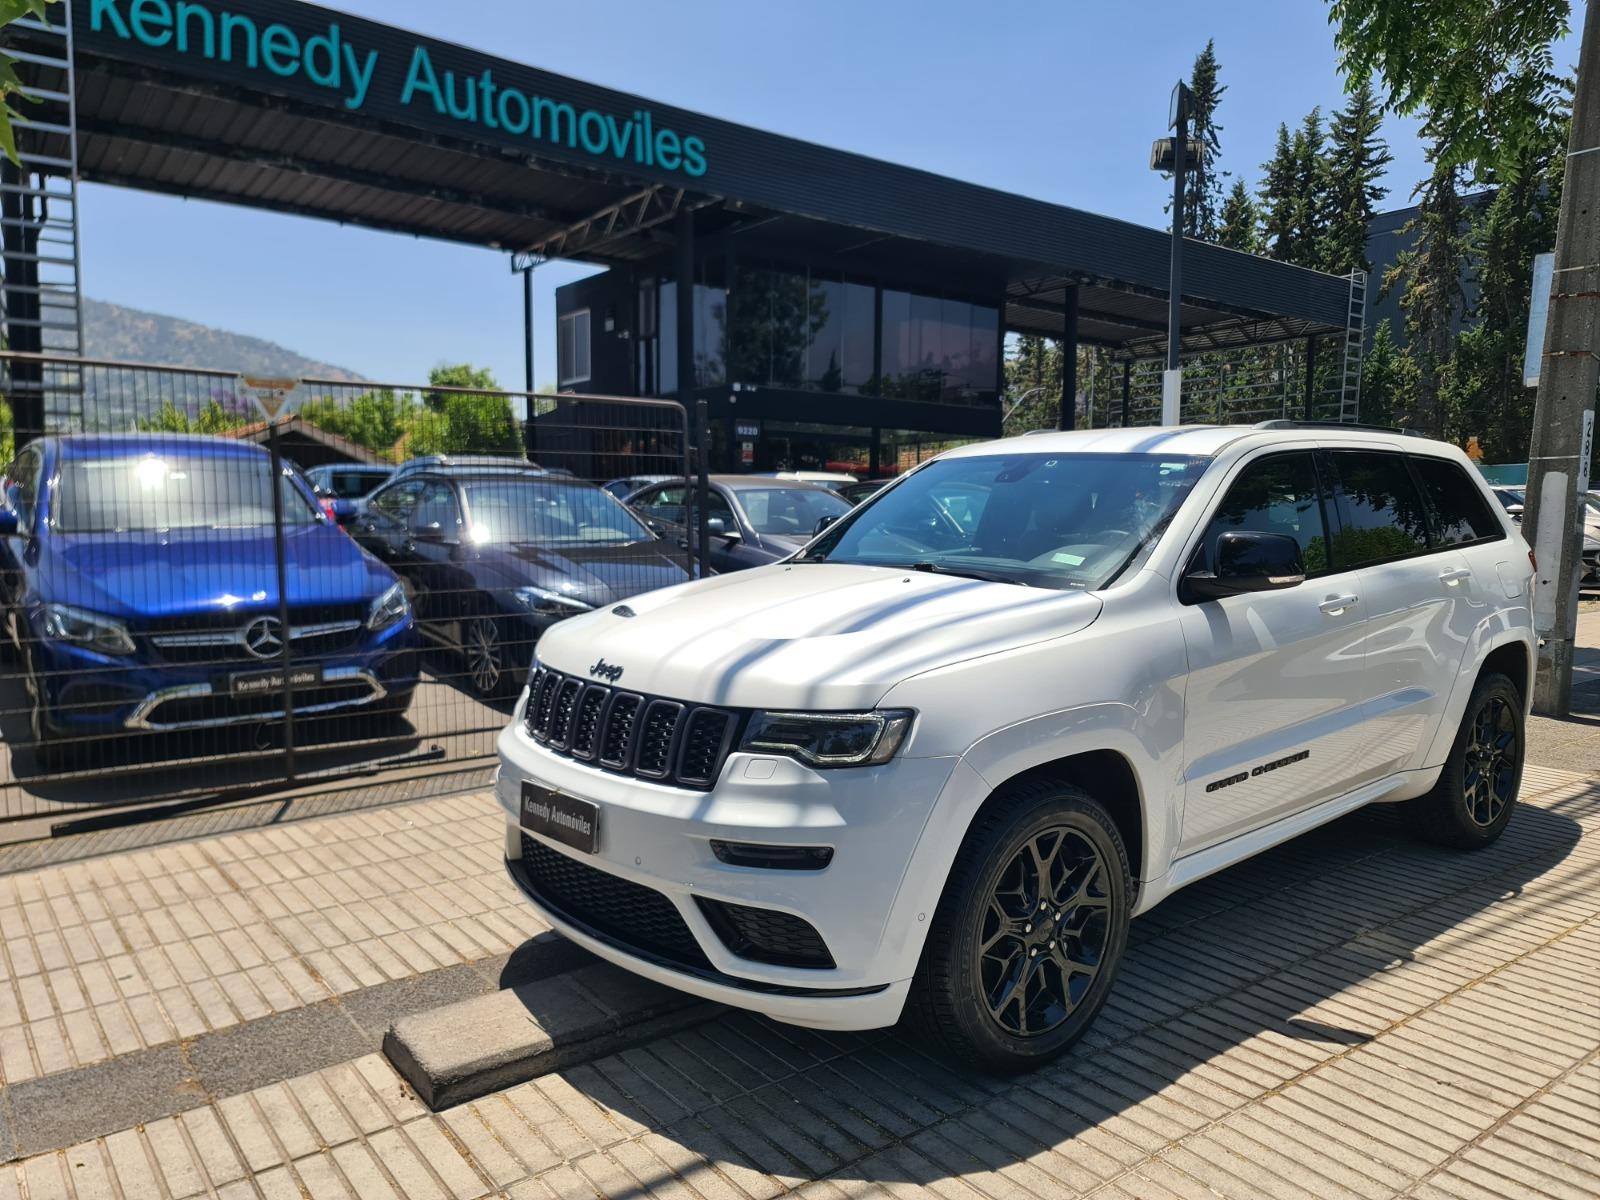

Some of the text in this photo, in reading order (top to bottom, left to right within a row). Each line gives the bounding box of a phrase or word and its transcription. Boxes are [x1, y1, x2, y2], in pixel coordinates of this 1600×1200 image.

[401, 45, 708, 177] Automoviles
[590, 658, 624, 682] Jeep
[524, 795, 551, 823] Kennedy
